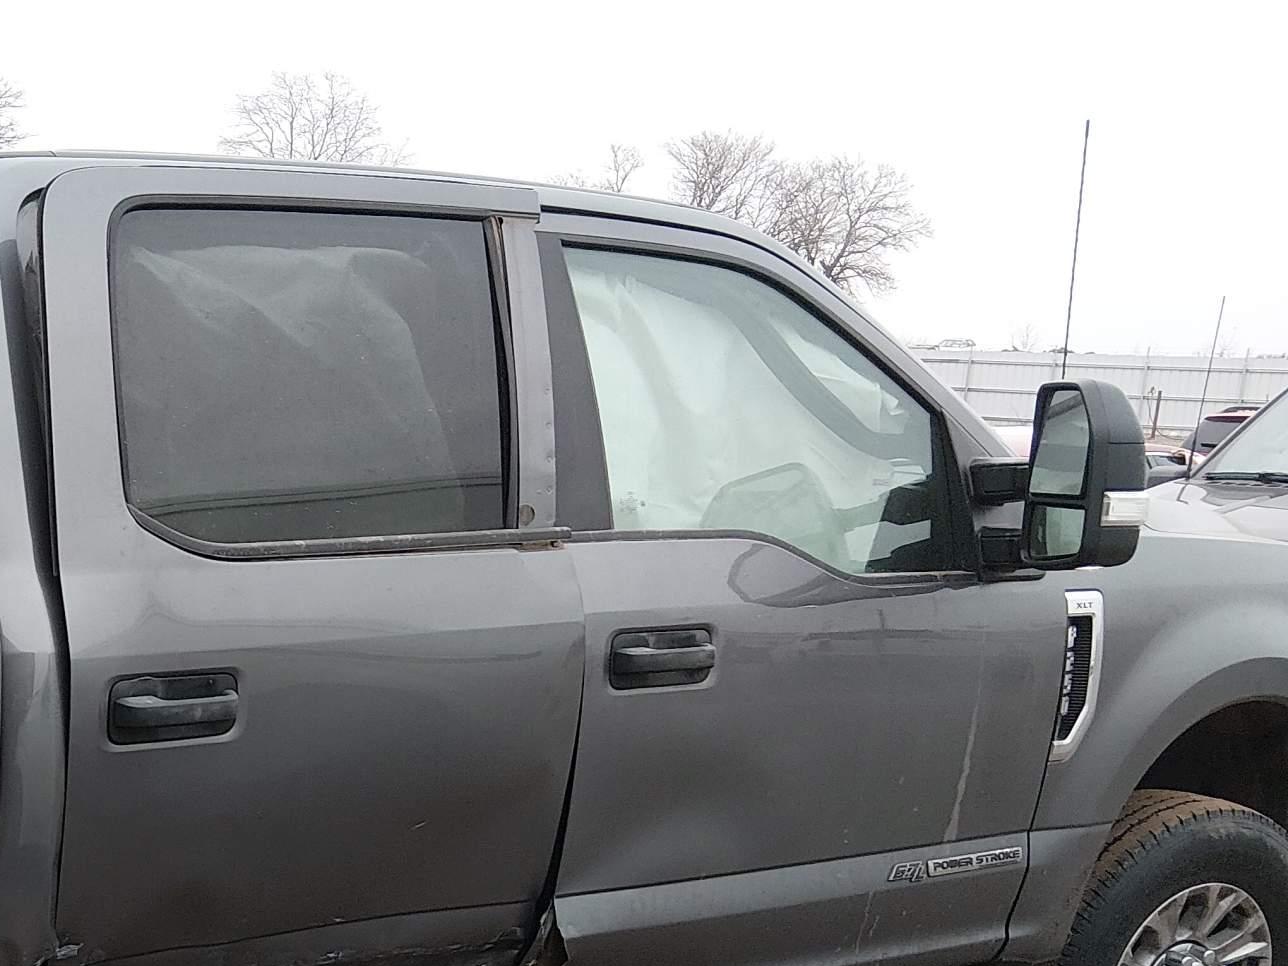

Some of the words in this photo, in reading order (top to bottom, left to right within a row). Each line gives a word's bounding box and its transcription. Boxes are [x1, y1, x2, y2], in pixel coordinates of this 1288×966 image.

[1076, 601, 1094, 609] XLT
[933, 857, 973, 872] POWER
[975, 849, 1020, 865] STROKE
